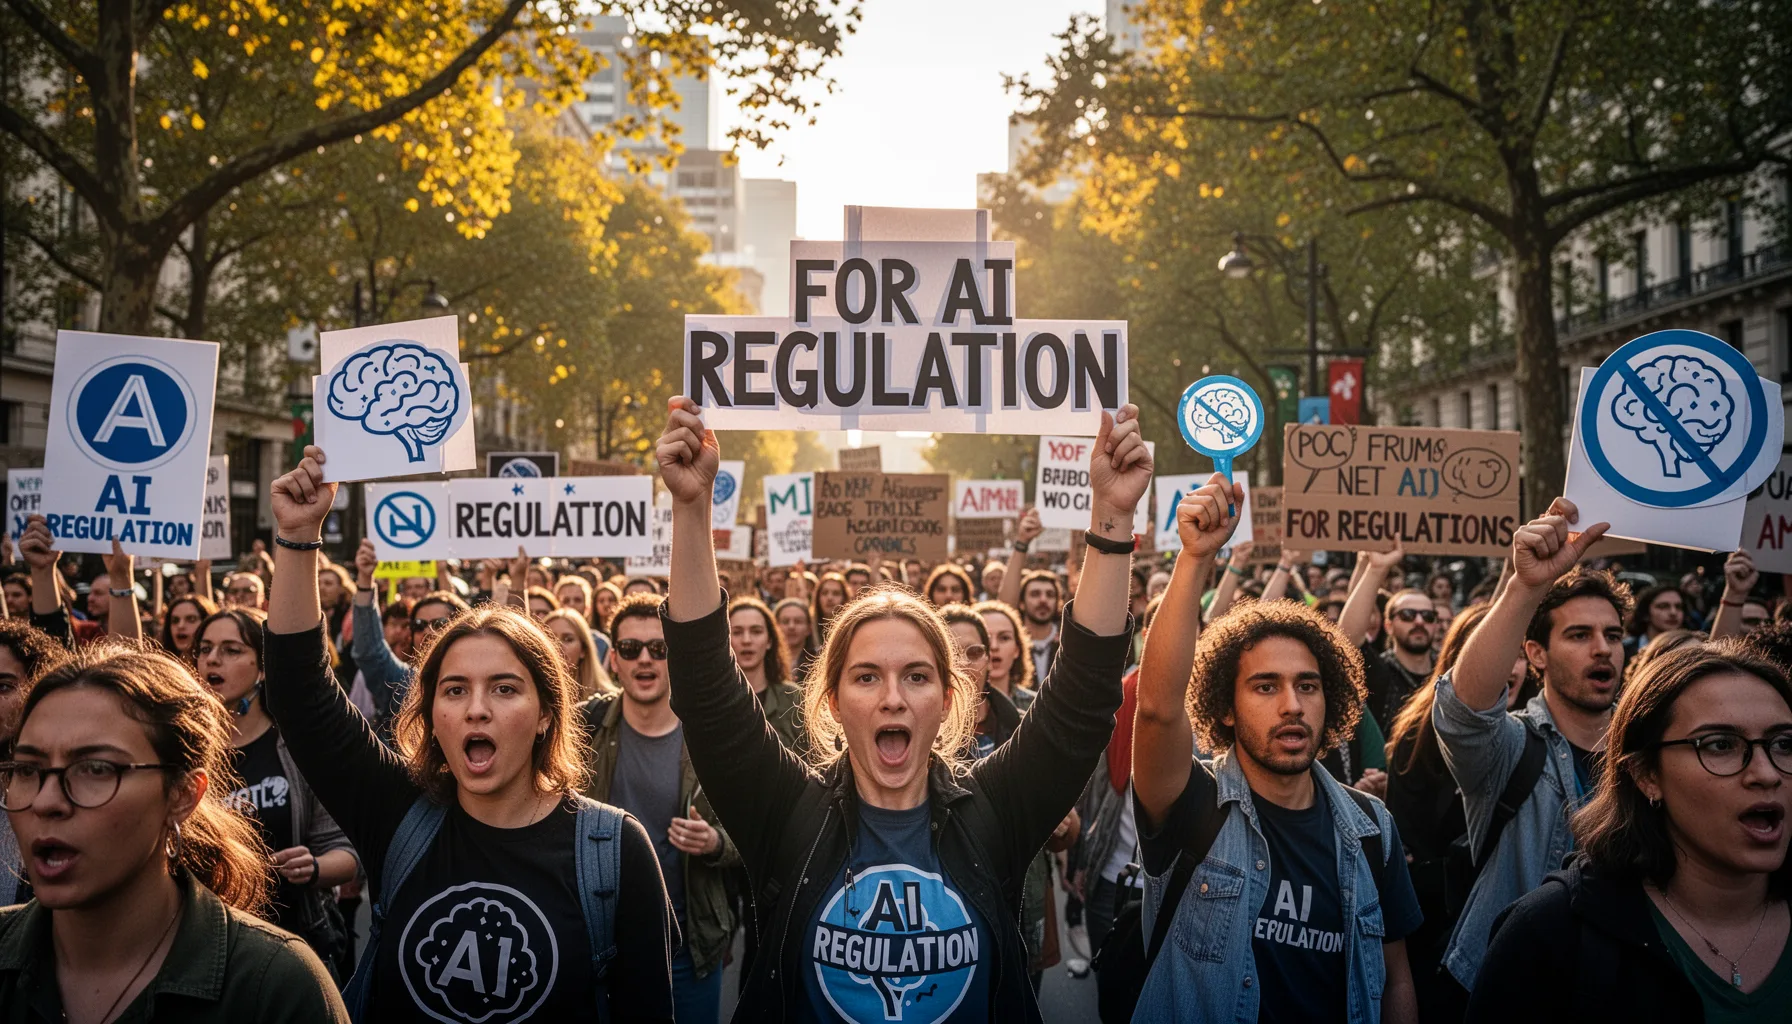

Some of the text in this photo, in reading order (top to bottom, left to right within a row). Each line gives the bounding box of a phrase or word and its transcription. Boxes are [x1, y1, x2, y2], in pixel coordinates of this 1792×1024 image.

[795, 258, 1012, 325] FOR AI
[690, 331, 1117, 409] REGULATION
[92, 374, 167, 447] A
[95, 475, 152, 515] AI
[1337, 466, 1386, 496] NET
[46, 513, 193, 546] REGULATION
[456, 501, 646, 538] REGULATION
[1286, 509, 1330, 538] FOR
[1337, 510, 1515, 547] REGULATIONS
[864, 881, 924, 932] AI
[1274, 880, 1313, 922] AI
[812, 925, 979, 973] REGULATION
